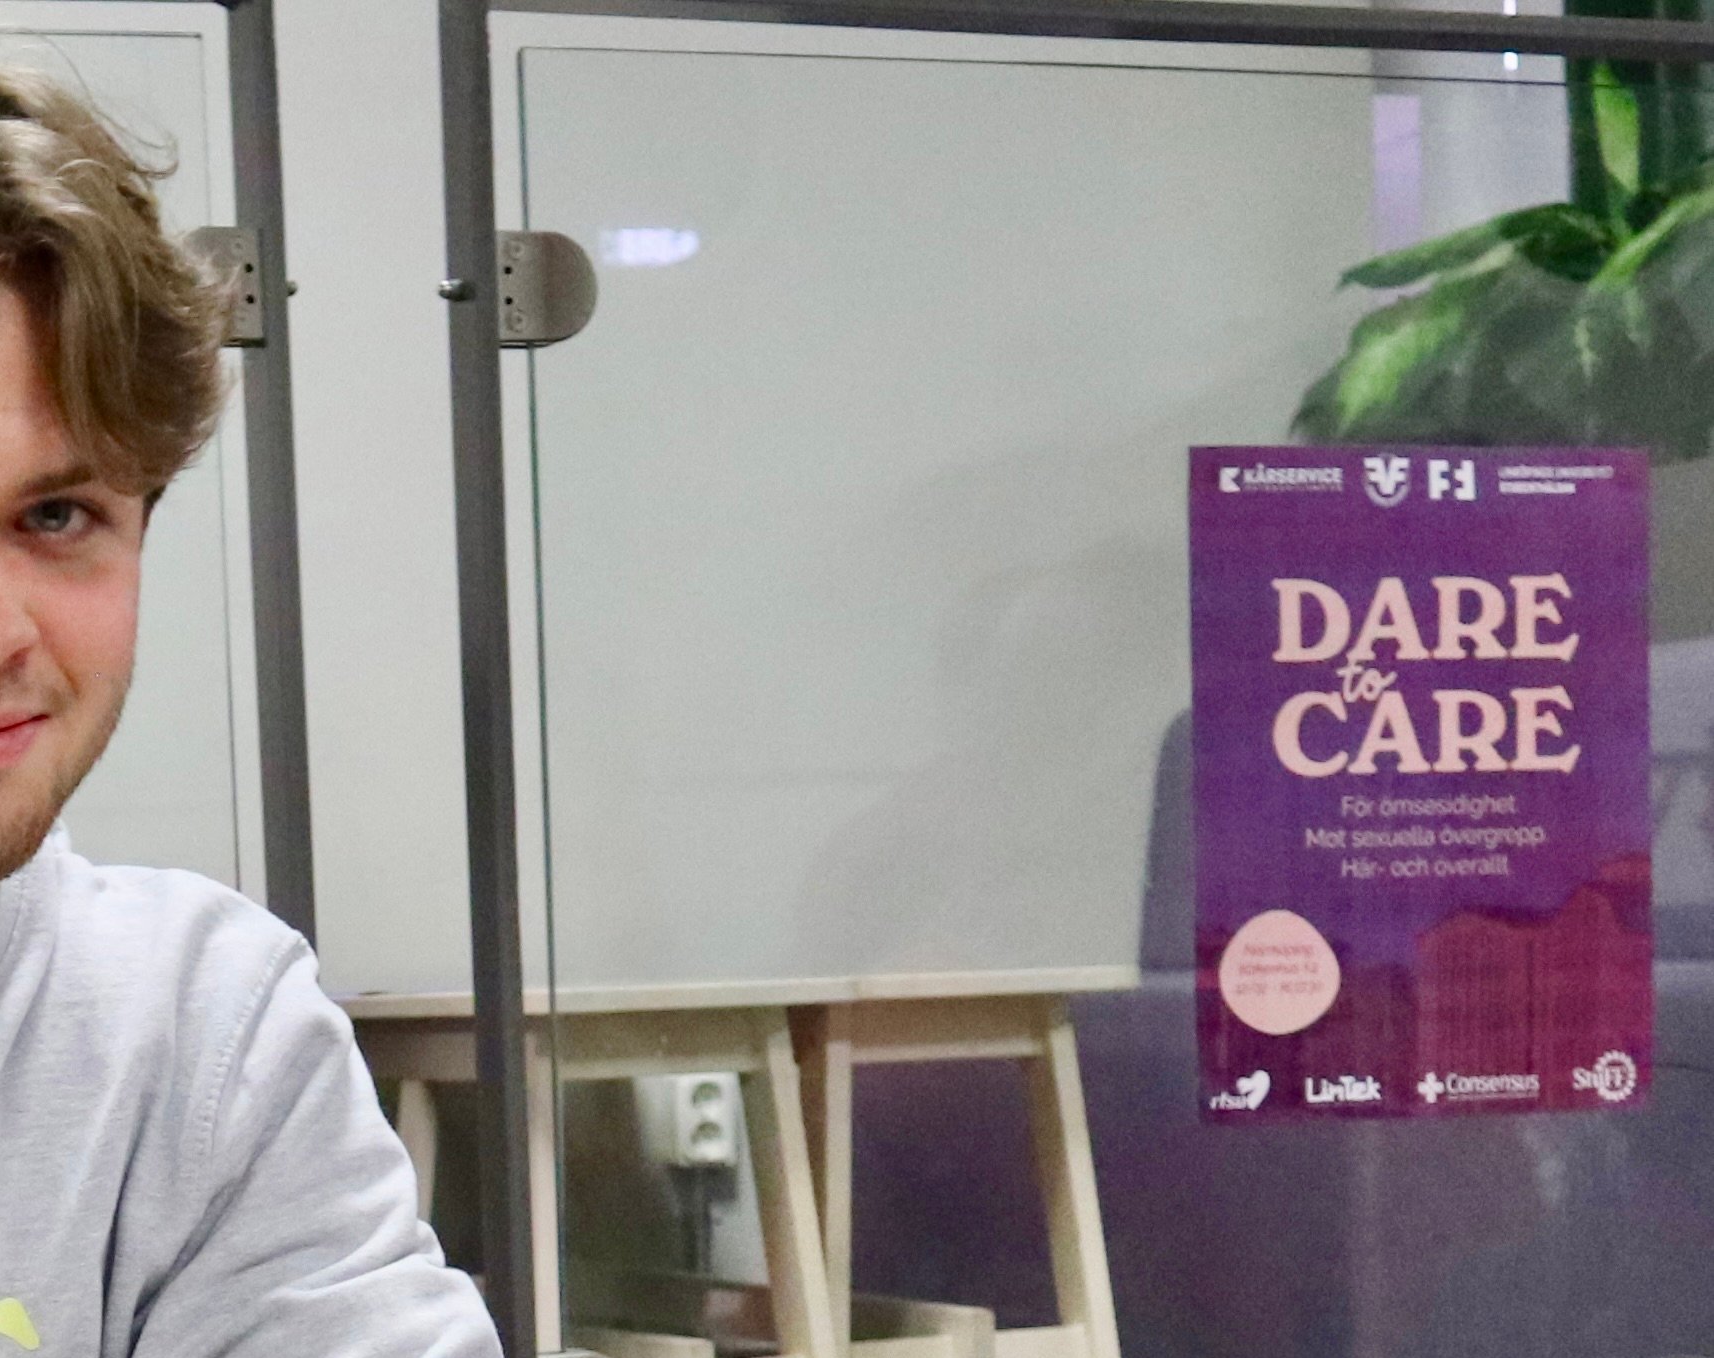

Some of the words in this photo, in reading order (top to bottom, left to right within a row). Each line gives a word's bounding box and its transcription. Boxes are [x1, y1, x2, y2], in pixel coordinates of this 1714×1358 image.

[1271, 572, 1580, 663] DARE
[1336, 658, 1398, 701] to
[1272, 685, 1581, 777] CARE
[1341, 795, 1375, 817] För
[1305, 827, 1346, 848] Mot
[1390, 858, 1430, 878] och
[1304, 1074, 1382, 1104] LinTek
[1445, 1072, 1540, 1094] Consensus
